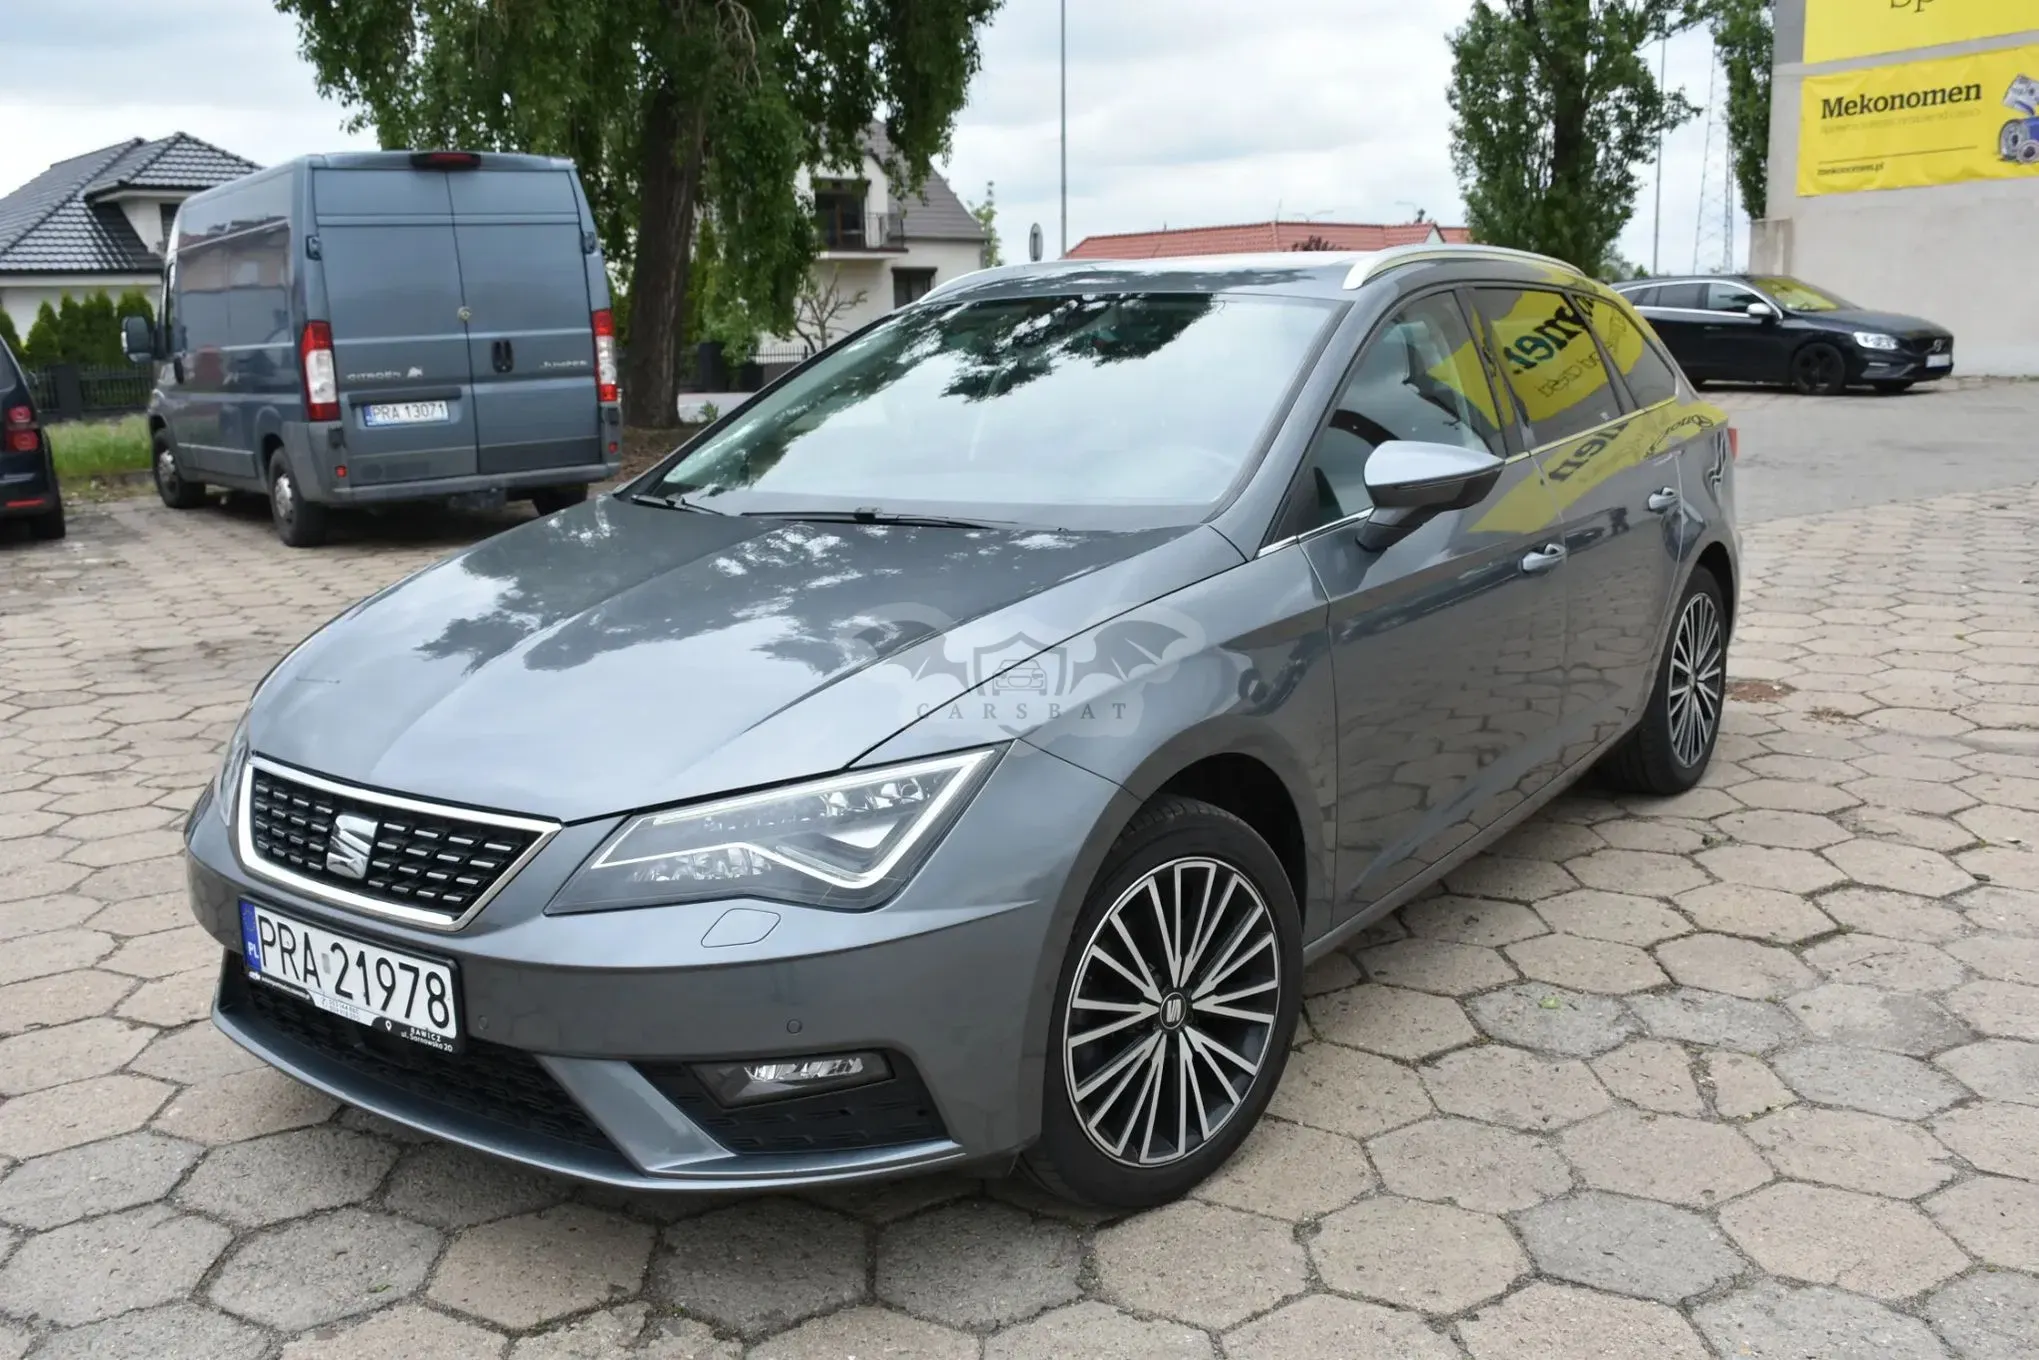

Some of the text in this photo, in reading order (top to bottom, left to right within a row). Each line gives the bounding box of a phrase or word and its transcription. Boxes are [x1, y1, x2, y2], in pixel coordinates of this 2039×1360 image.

[1821, 83, 1982, 119] Mekonomen
[372, 402, 446, 420] PRA 13071
[257, 914, 450, 1029] PRA 21978
[443, 1043, 453, 1053] 20
